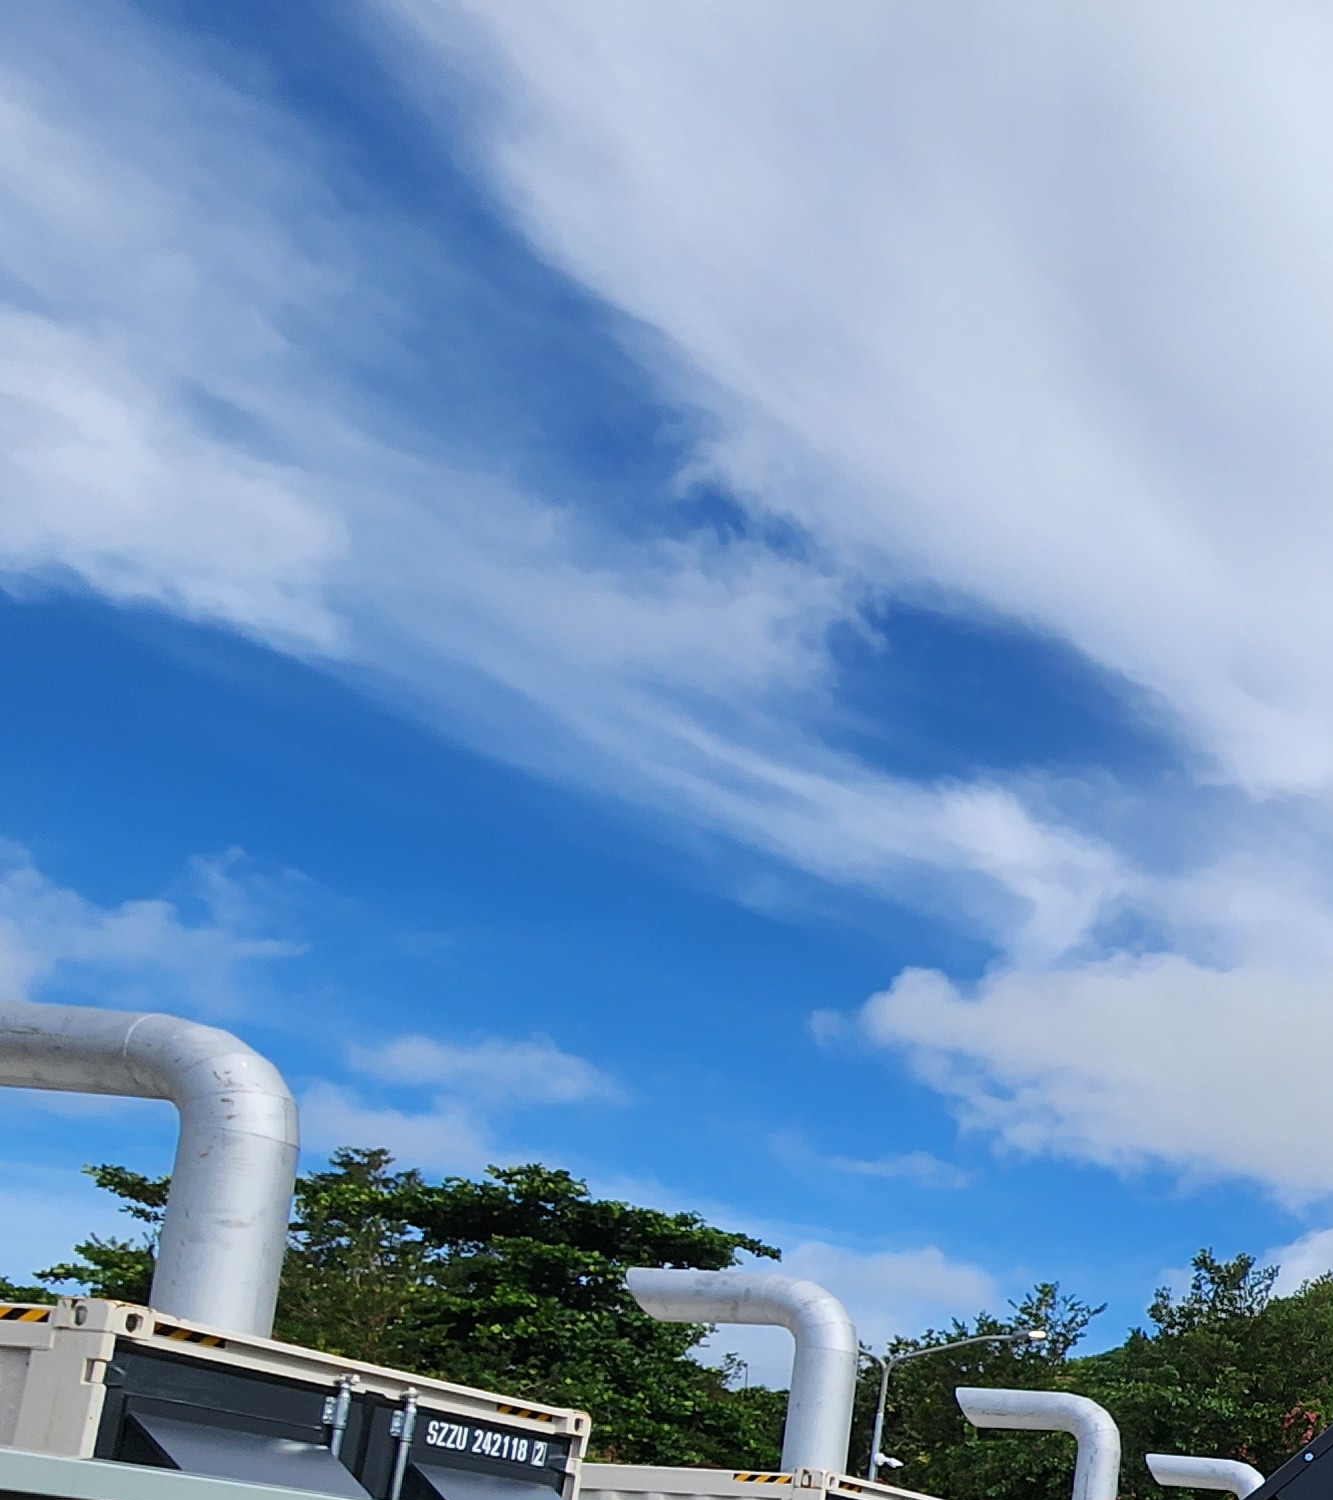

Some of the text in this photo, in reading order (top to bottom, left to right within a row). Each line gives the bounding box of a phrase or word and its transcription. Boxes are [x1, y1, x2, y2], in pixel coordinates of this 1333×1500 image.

[426, 1420, 547, 1466] SZZU 242118 2
